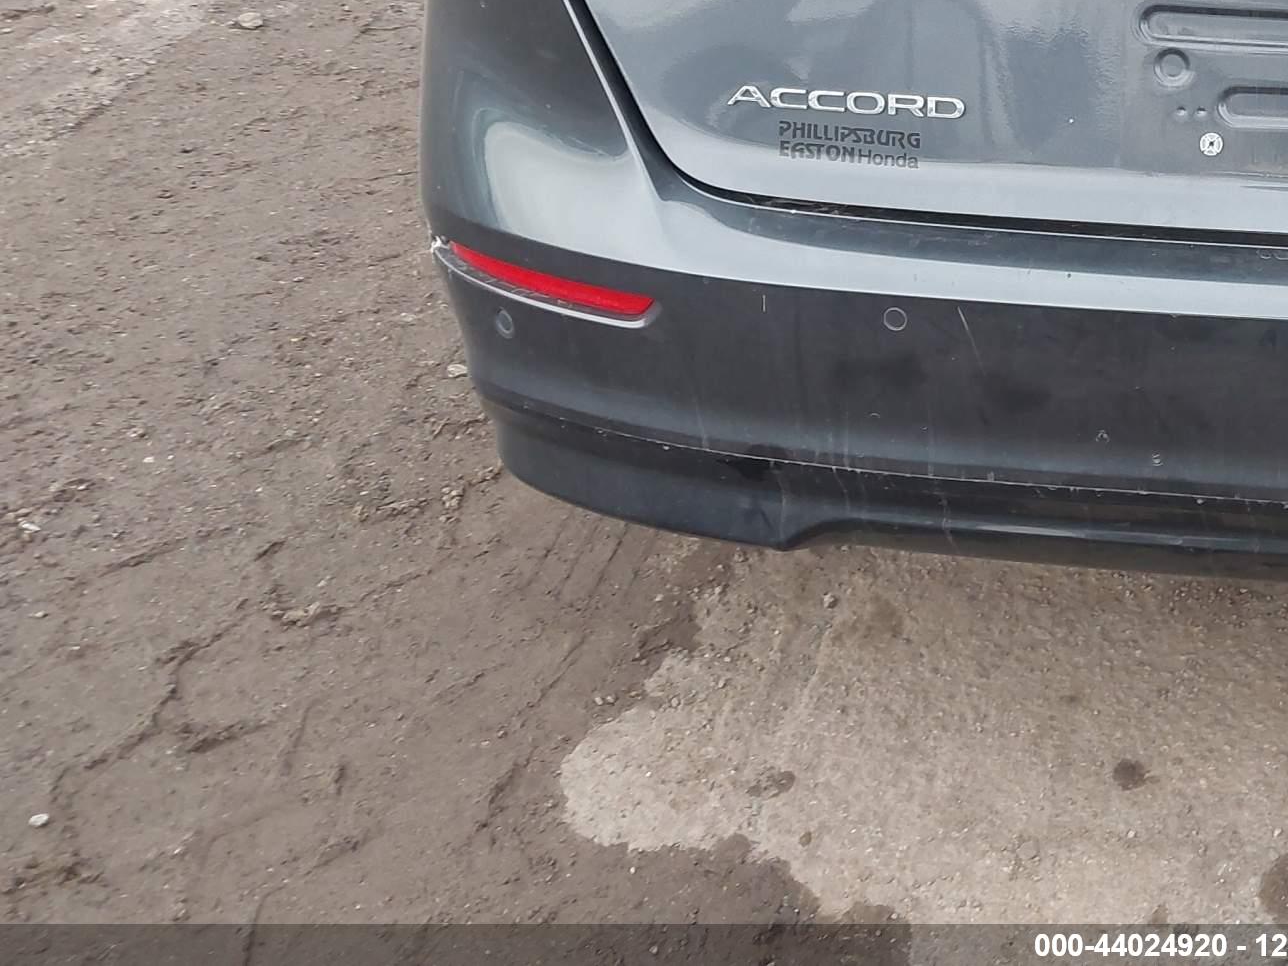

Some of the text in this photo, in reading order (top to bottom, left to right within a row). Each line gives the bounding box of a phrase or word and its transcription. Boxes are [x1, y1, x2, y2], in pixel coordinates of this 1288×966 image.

[727, 85, 966, 119] ACCORD
[778, 120, 921, 149] PHILLIPSBURG
[778, 140, 919, 169] EASTON Honda
